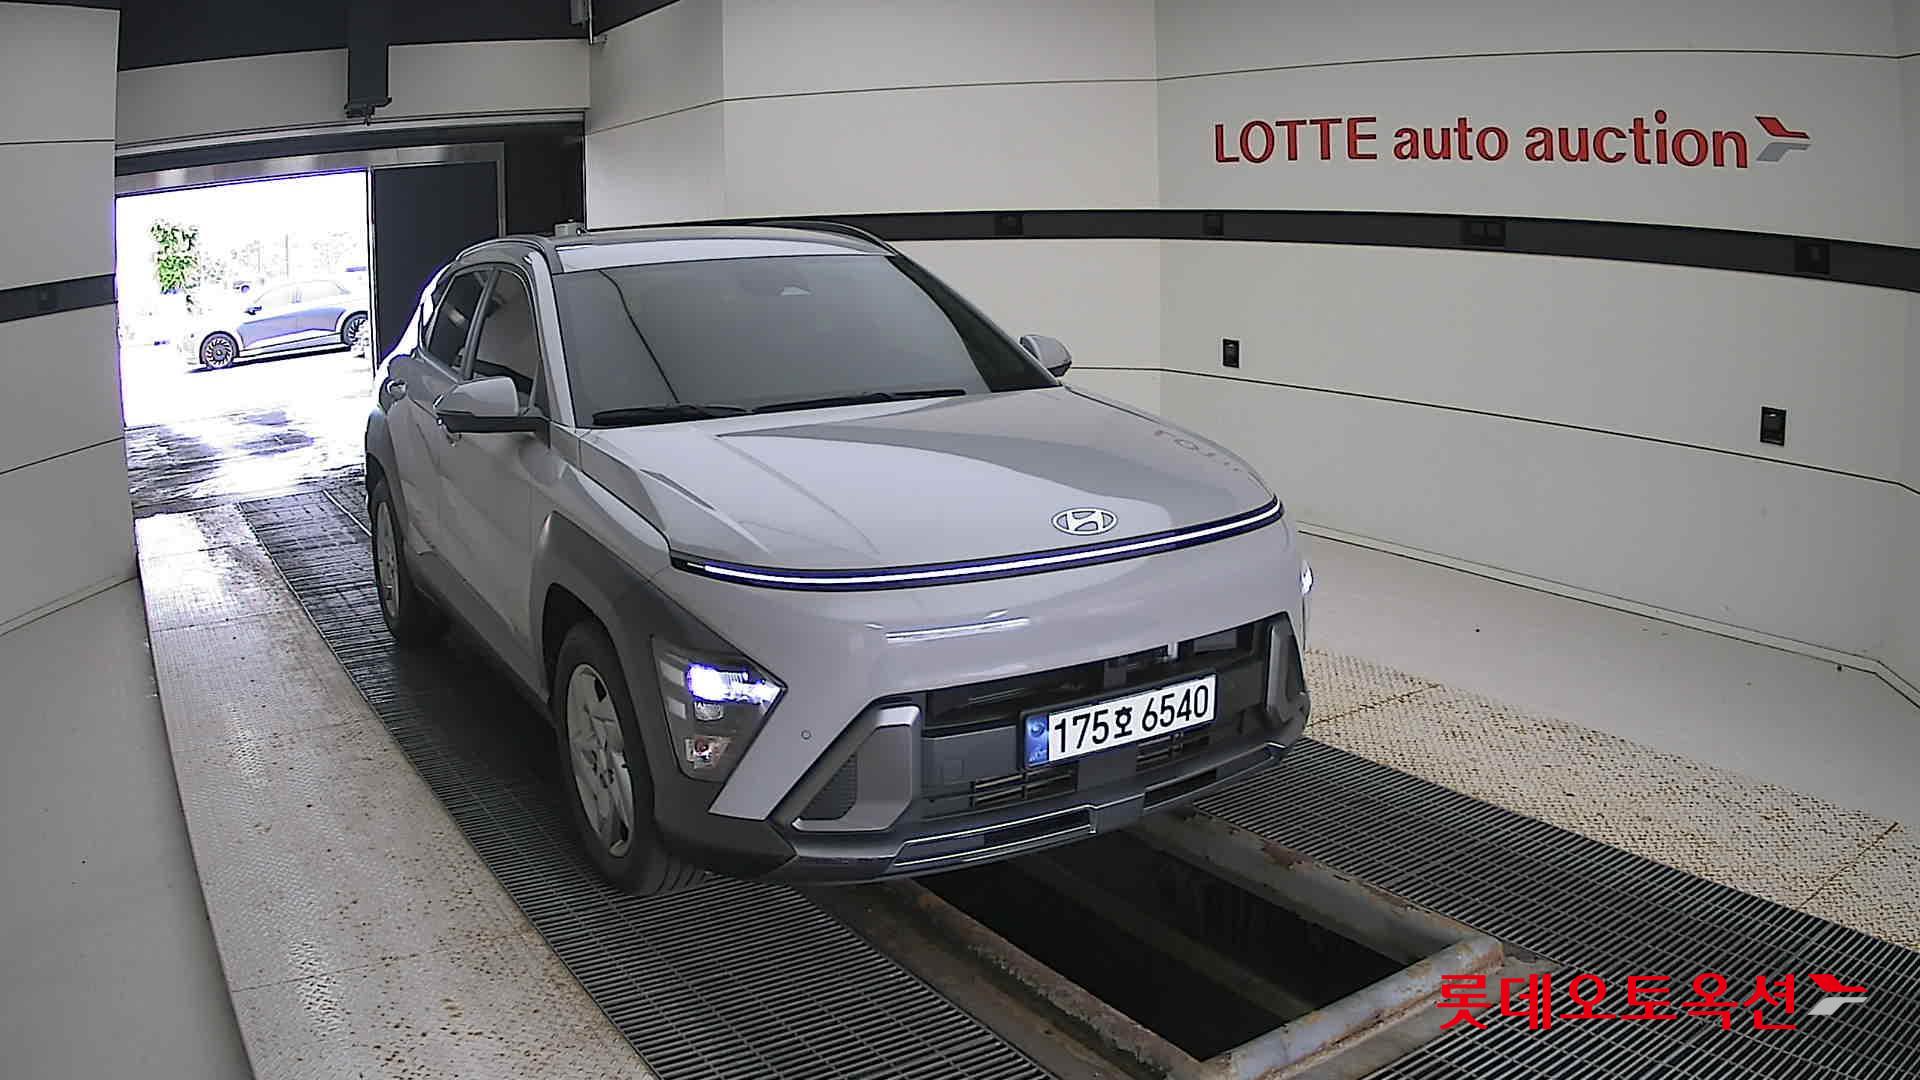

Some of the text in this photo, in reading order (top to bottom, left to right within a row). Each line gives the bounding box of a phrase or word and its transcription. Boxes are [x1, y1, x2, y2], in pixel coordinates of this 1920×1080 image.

[1215, 110, 1748, 169] LOTTE auto auction
[1054, 685, 1209, 753] 175호 6540
